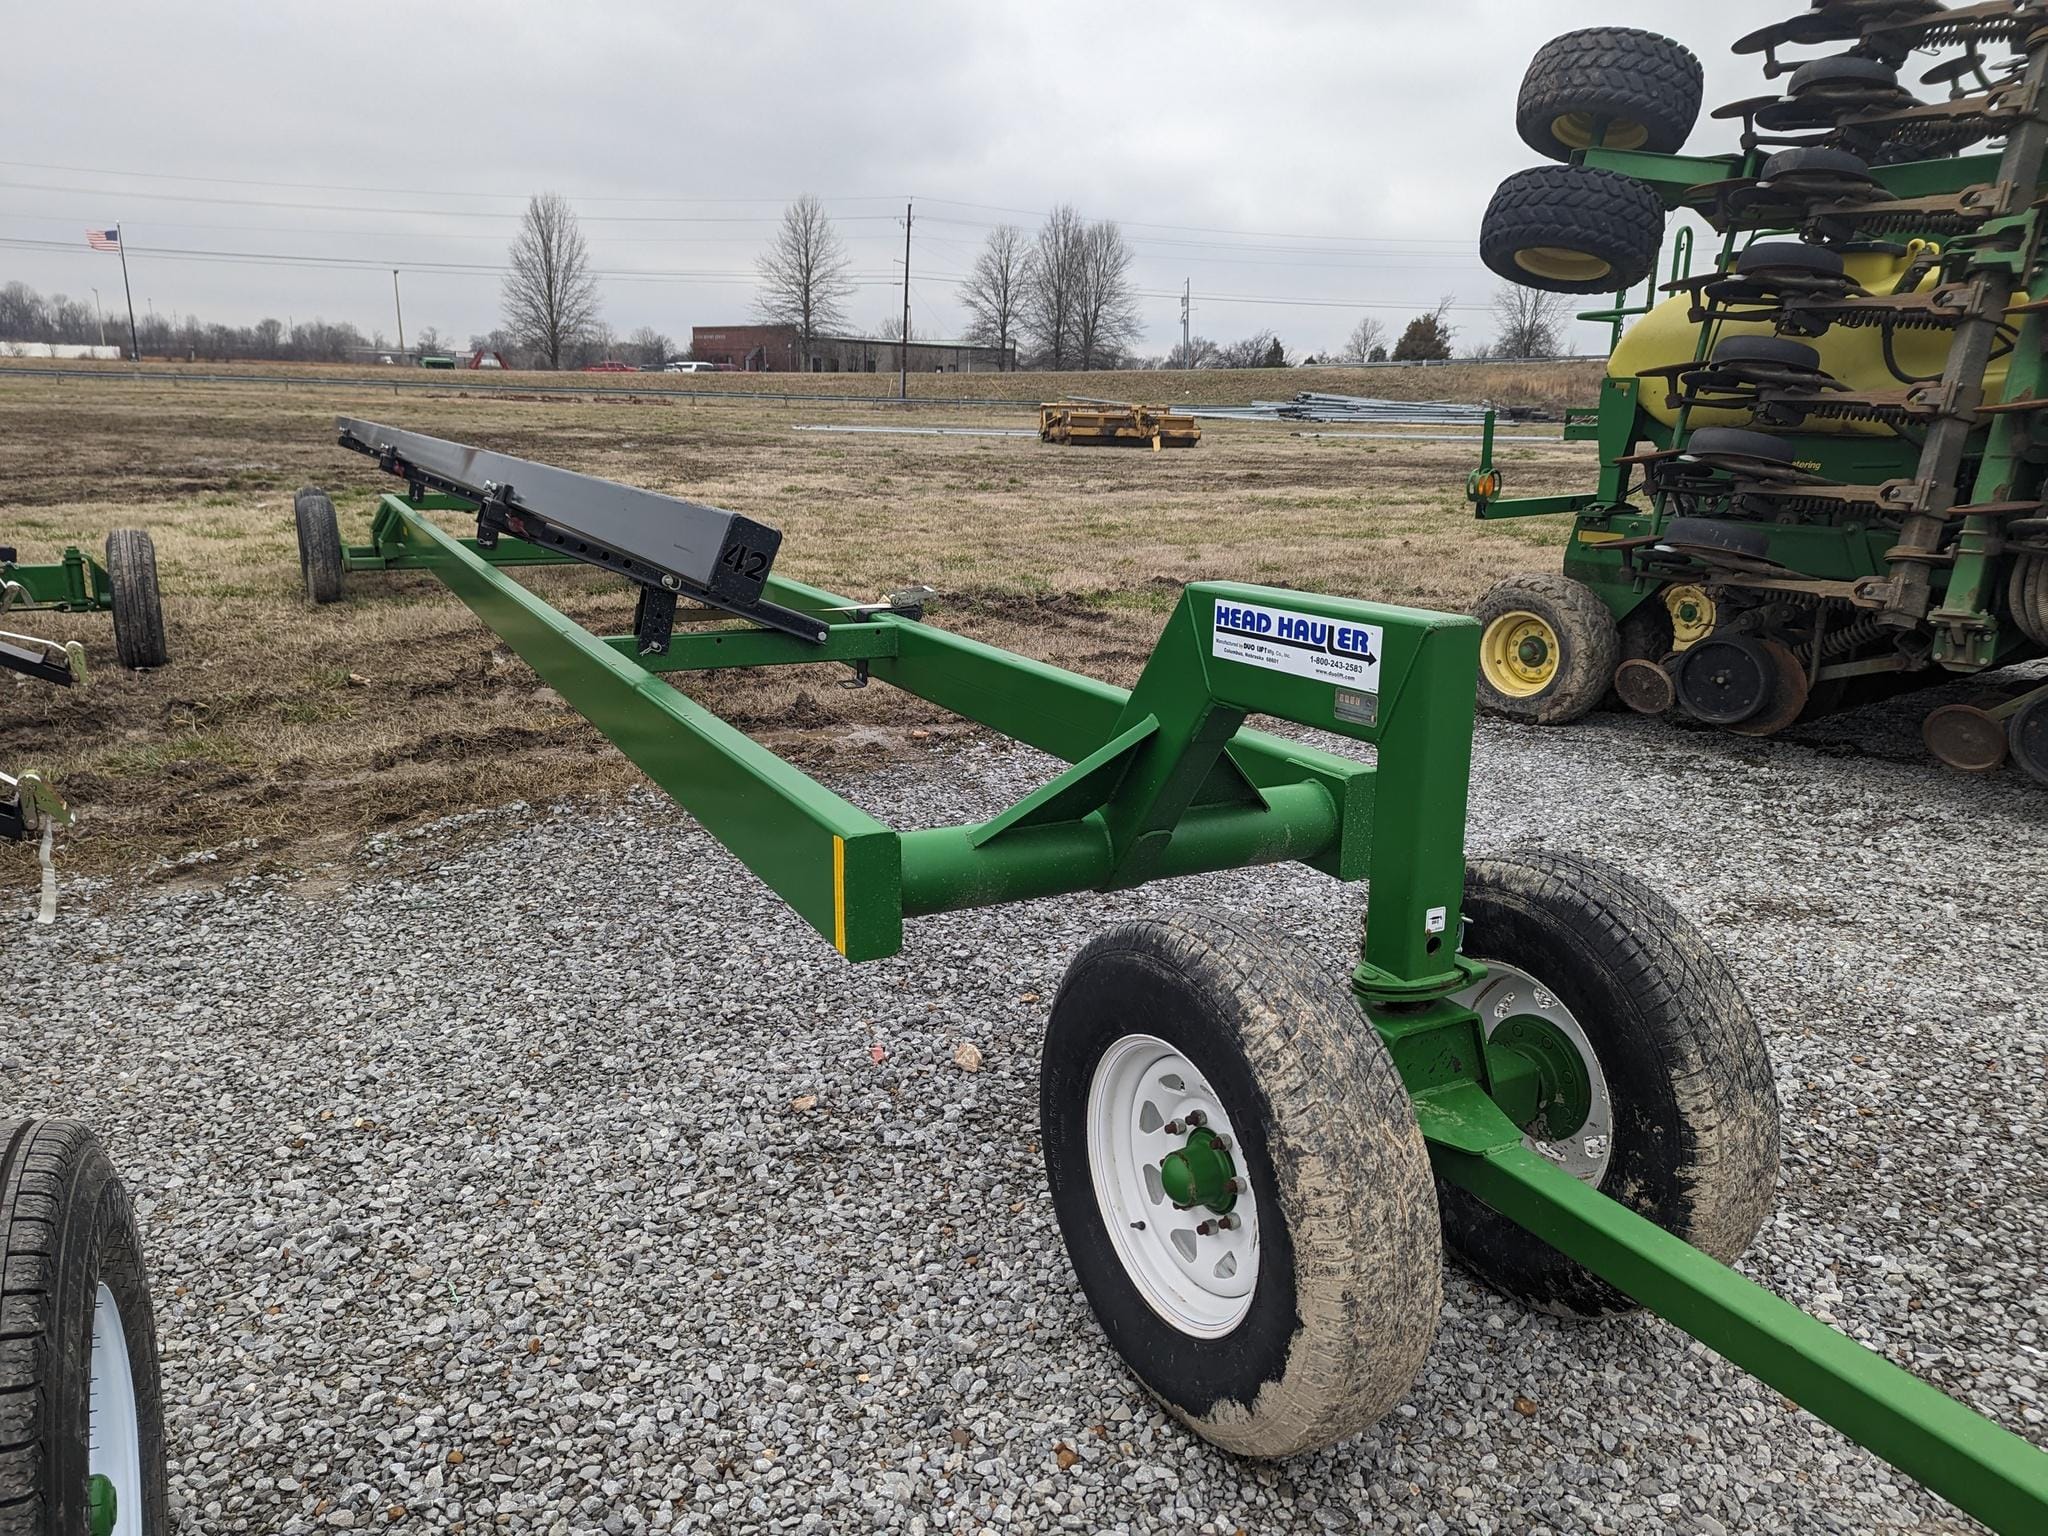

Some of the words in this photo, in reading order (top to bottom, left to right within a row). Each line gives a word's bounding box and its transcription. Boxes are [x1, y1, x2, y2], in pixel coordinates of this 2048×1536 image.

[722, 543, 768, 583] 42
[1216, 605, 1272, 633] HEAD
[1277, 616, 1369, 654] HAULER
[1215, 638, 1239, 648] Manufactured
[1243, 642, 1256, 651] DUO
[1223, 647, 1245, 657] Columbus,
[1244, 651, 1265, 661] Nebraska
[1310, 655, 1363, 674] 1-800-243-2583
[1315, 668, 1356, 681] www.duolift.com
